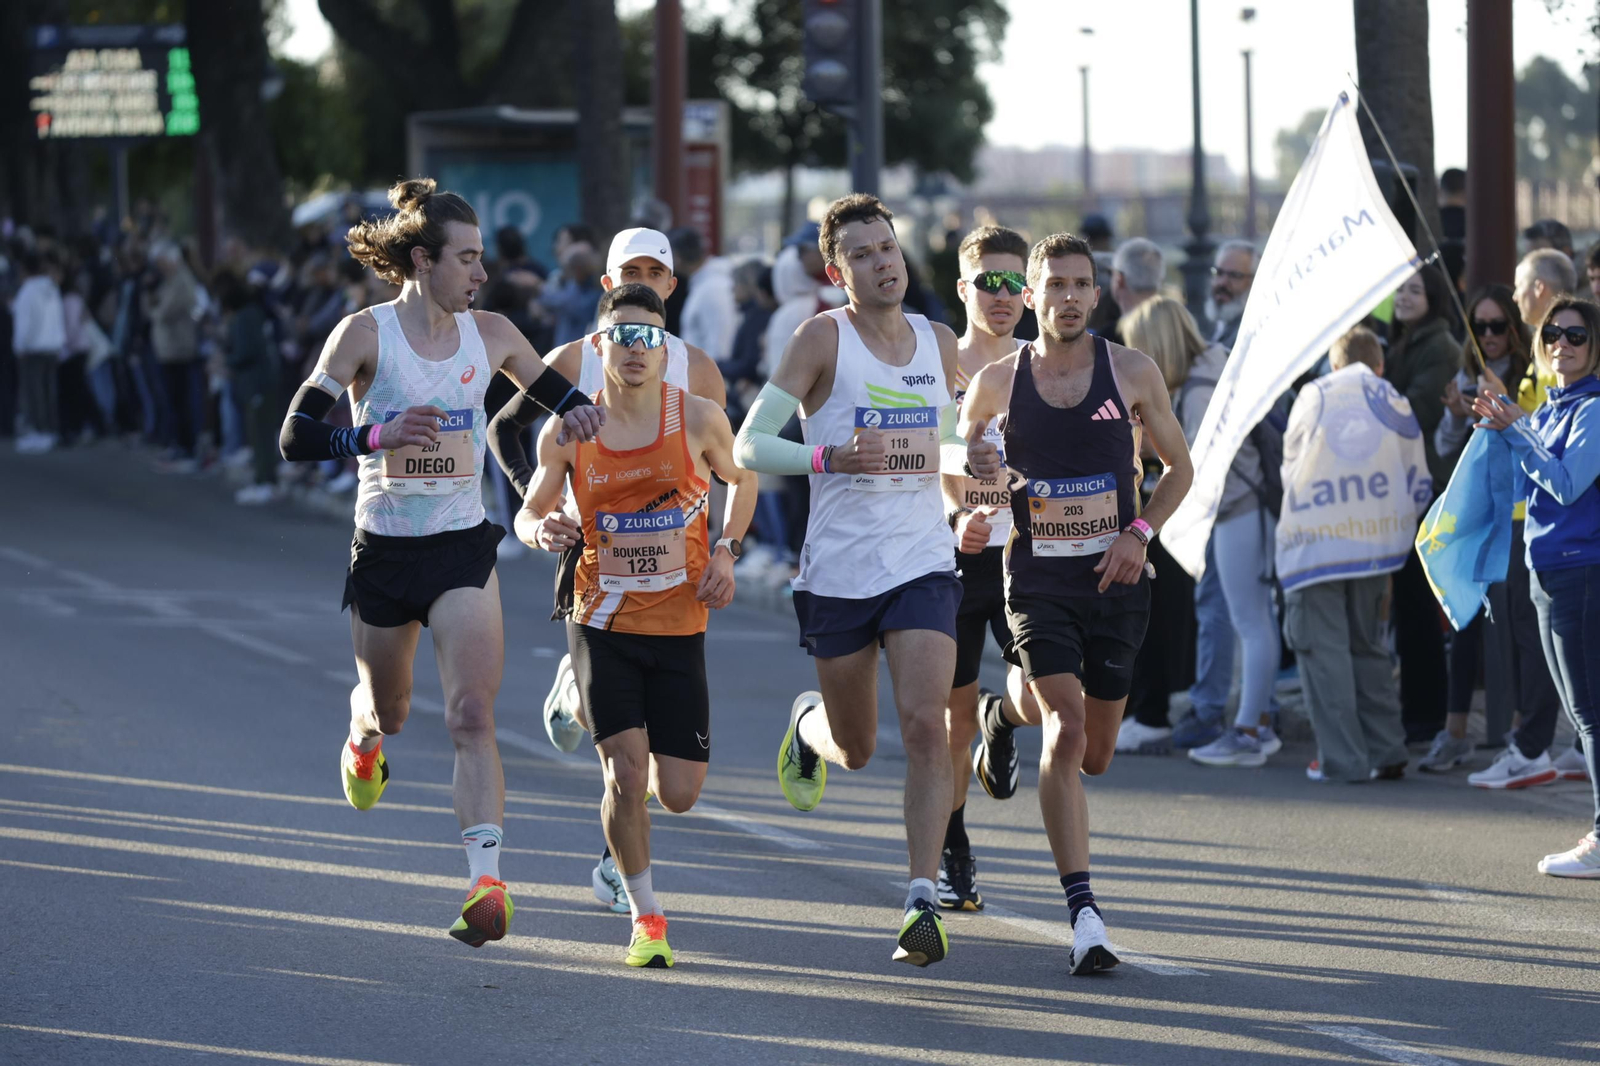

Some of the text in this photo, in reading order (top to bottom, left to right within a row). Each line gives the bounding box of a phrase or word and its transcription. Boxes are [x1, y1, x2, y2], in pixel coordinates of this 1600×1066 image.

[902, 373, 936, 387] sparta
[436, 415, 464, 427] RICH
[887, 412, 928, 425] ZURICH
[890, 438, 909, 449] 118
[405, 457, 455, 474] DIEGO
[884, 454, 926, 471] ONID
[1057, 479, 1105, 494] ZURICH
[1289, 471, 1390, 513] Lane
[1063, 505, 1084, 516] 203
[625, 514, 673, 529] ZURICH
[1032, 514, 1118, 537] MORISSEAU
[612, 544, 670, 558] BOUKEBAL
[627, 558, 658, 574] 123
